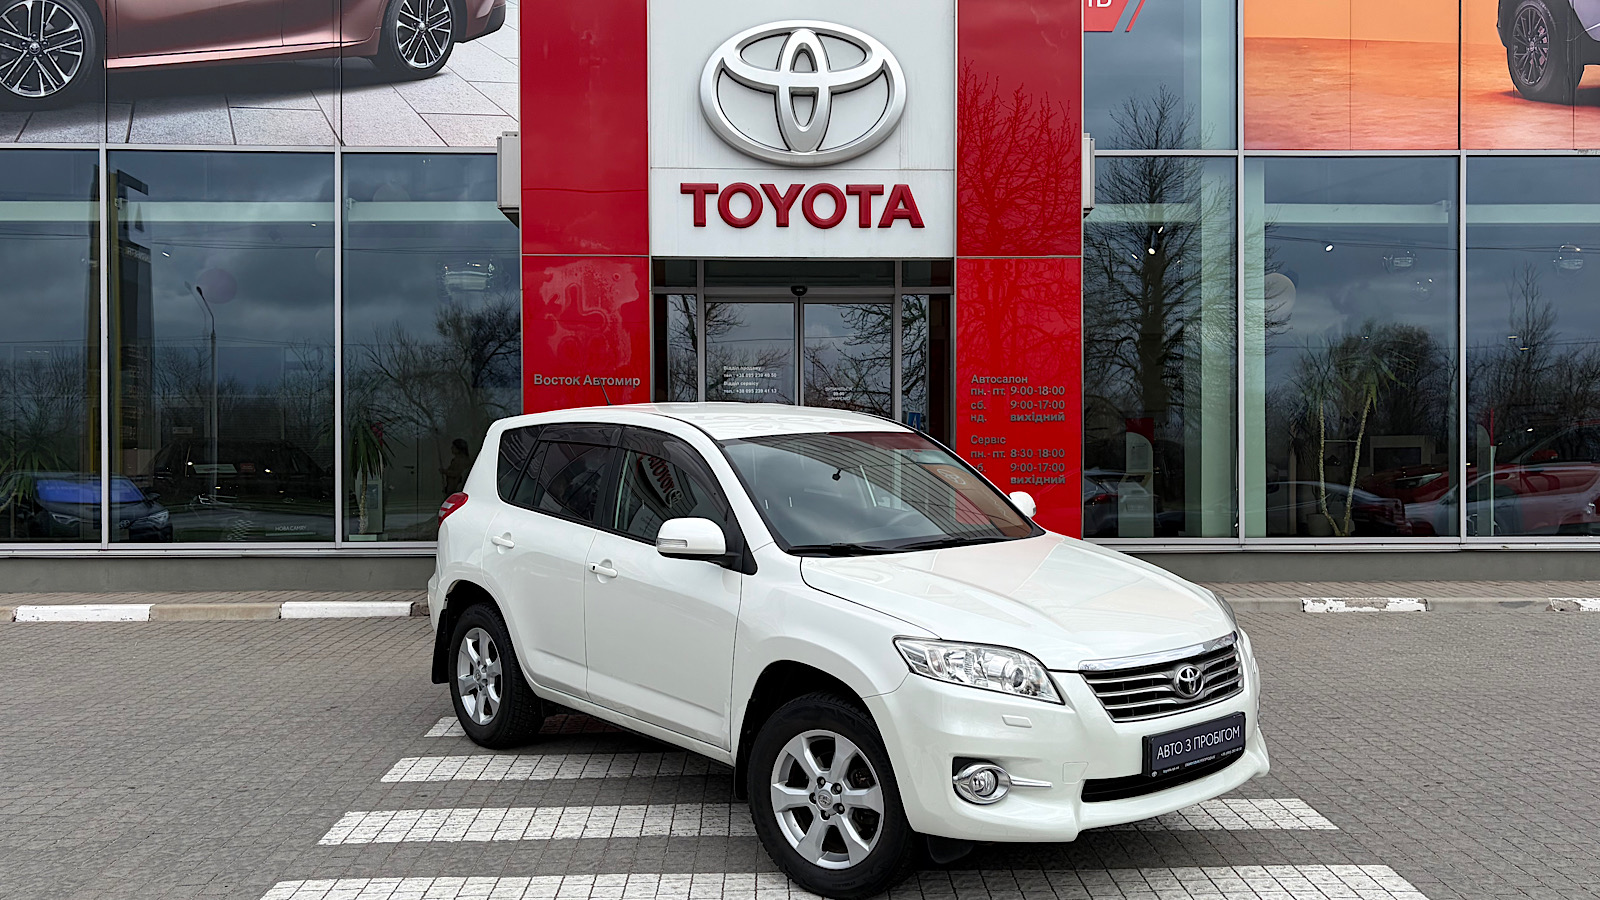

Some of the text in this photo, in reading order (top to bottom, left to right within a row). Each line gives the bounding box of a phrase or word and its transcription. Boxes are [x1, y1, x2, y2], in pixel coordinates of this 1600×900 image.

[680, 182, 925, 229] TOYOTA
[533, 374, 641, 389] Восток Автомир
[971, 374, 1028, 384] Автосалон
[1010, 386, 1065, 396] 9:00-18:00
[970, 400, 1065, 410] сб. 9:00-17:00
[970, 412, 1065, 423] нд. вихідний
[970, 435, 1007, 446] Сервіс
[973, 463, 1065, 473] б. 9:00-17:00
[1010, 475, 1066, 485] вихідний
[1157, 741, 1183, 760] АВТО
[1193, 725, 1240, 750] ПРОБІГОМ
